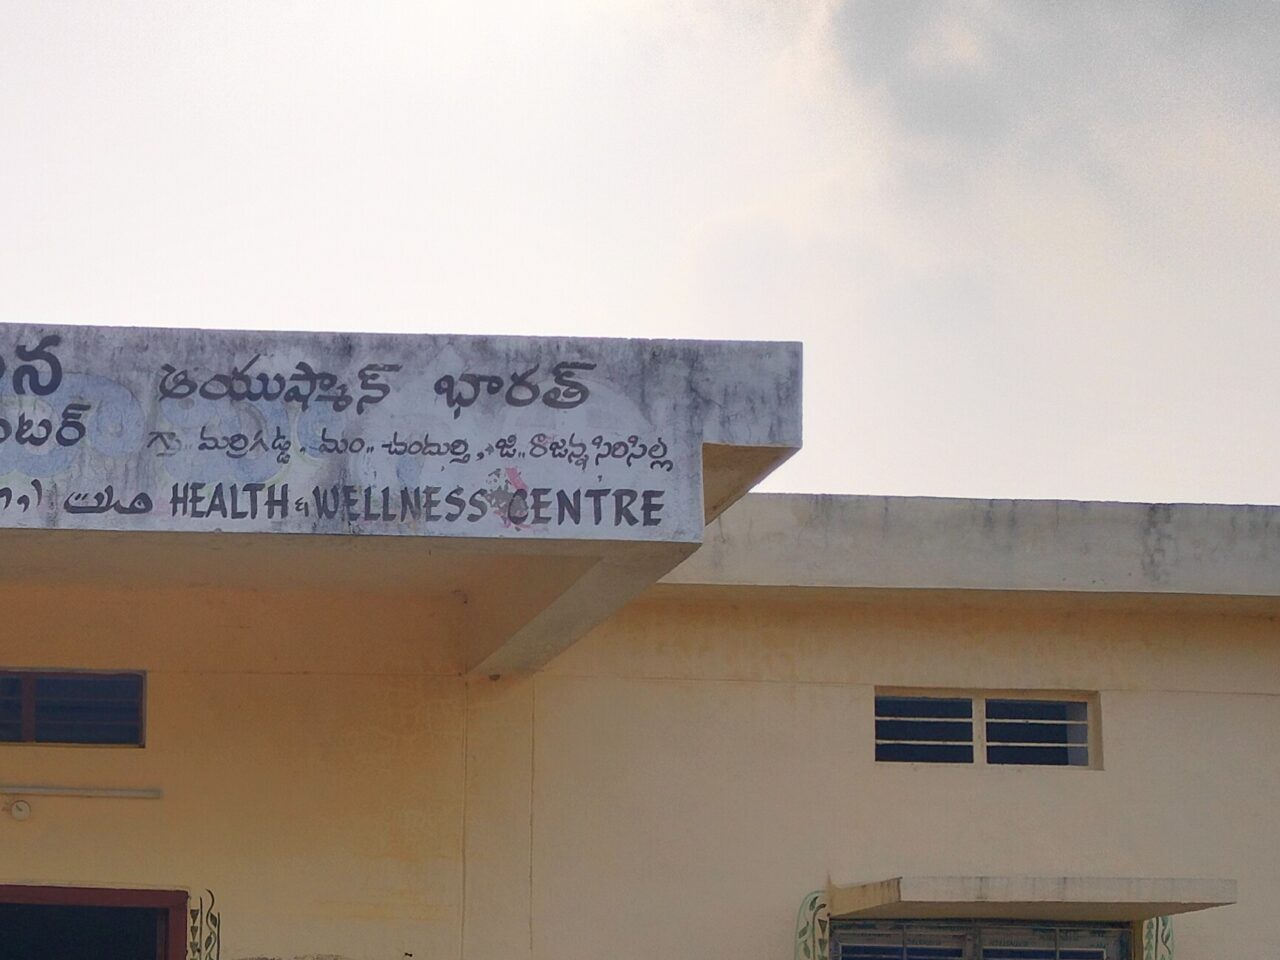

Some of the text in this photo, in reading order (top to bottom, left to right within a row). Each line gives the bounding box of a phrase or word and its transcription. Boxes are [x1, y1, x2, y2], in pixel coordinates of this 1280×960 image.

[433, 361, 598, 420] భారత్
[170, 481, 289, 520] HEALTH
[312, 484, 488, 523] WELLNESS
[508, 488, 666, 527] CENTRE
